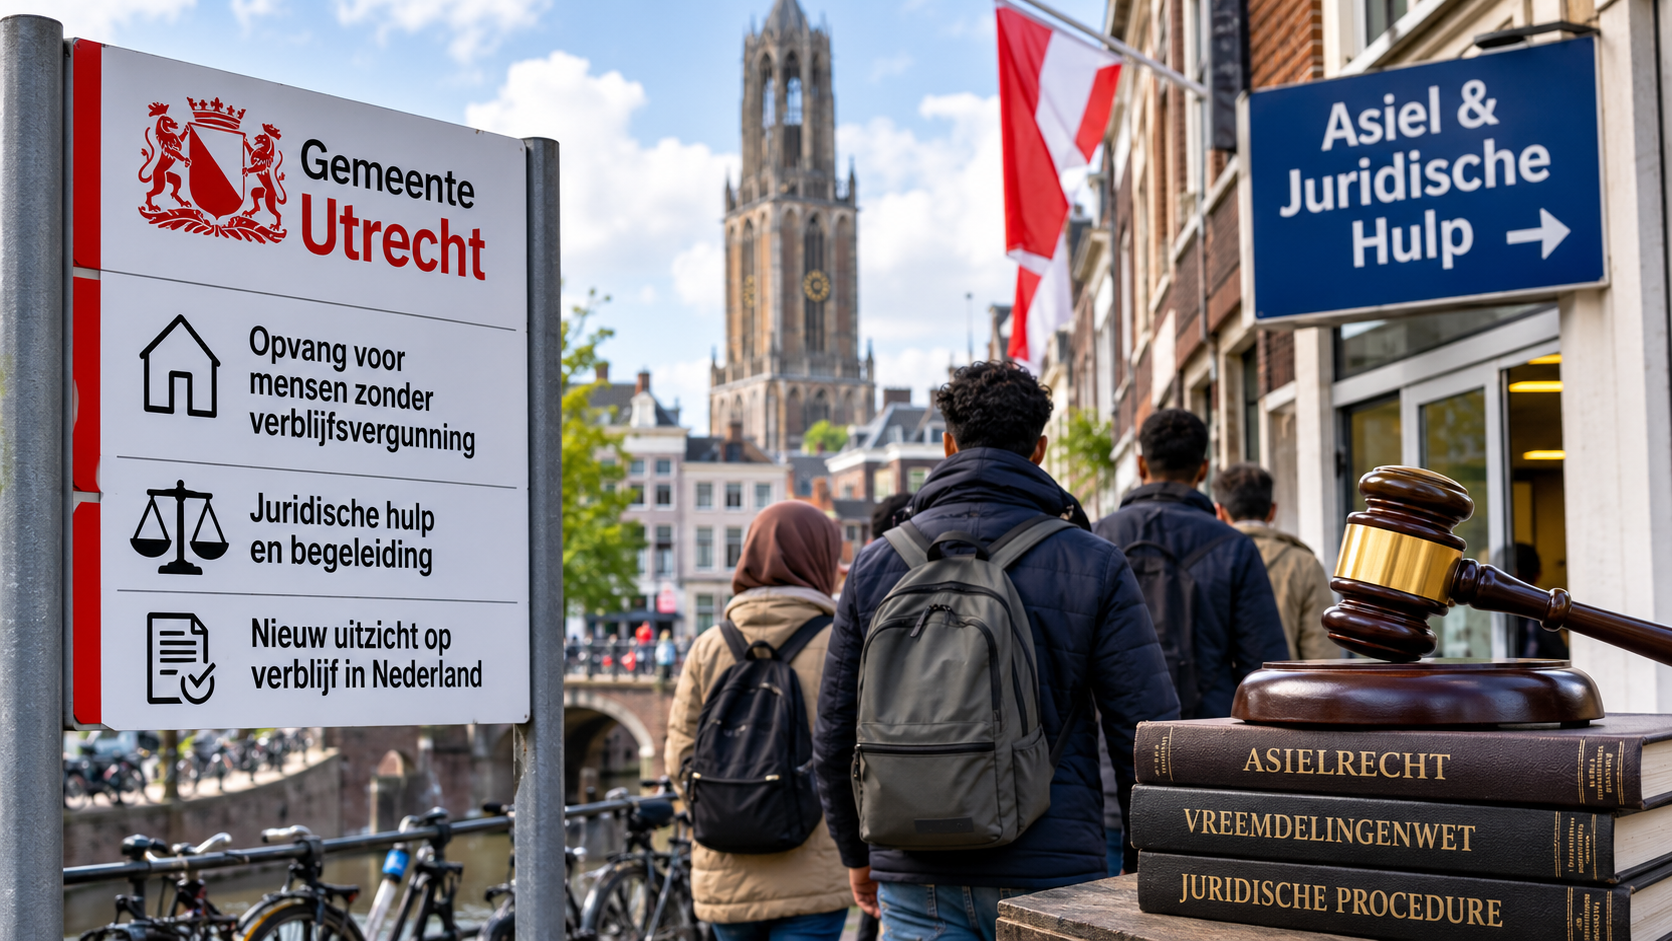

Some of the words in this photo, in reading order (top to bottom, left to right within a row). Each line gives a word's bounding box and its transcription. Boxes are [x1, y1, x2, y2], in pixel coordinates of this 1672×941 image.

[1321, 85, 1441, 151] Asiel
[1457, 79, 1499, 129] &
[300, 138, 475, 210] Gemeente
[1279, 138, 1551, 218] Juridische
[301, 192, 486, 281] Utrecht
[1352, 209, 1474, 270] Hulp
[249, 325, 347, 373] Opvang
[353, 345, 406, 372] voor
[249, 371, 348, 404] mensen
[354, 381, 434, 412] zonder
[249, 407, 475, 460] verblijfsvergunning
[249, 492, 380, 529] Juridische
[386, 500, 435, 538] hulp
[250, 539, 283, 564] en
[290, 534, 433, 577] begeleiding
[251, 617, 328, 649] Nieuw
[334, 619, 419, 650] uitzicht
[424, 627, 452, 657] op
[250, 658, 339, 697] verblijf
[345, 658, 366, 689] in
[372, 659, 483, 689] Nederland
[1242, 747, 1451, 781] ASIELRECHT
[1183, 808, 1476, 852] VREEMDELINGENWET
[1179, 873, 1328, 912] JURIDISCHE
[1335, 886, 1503, 928] PROCEDURE
